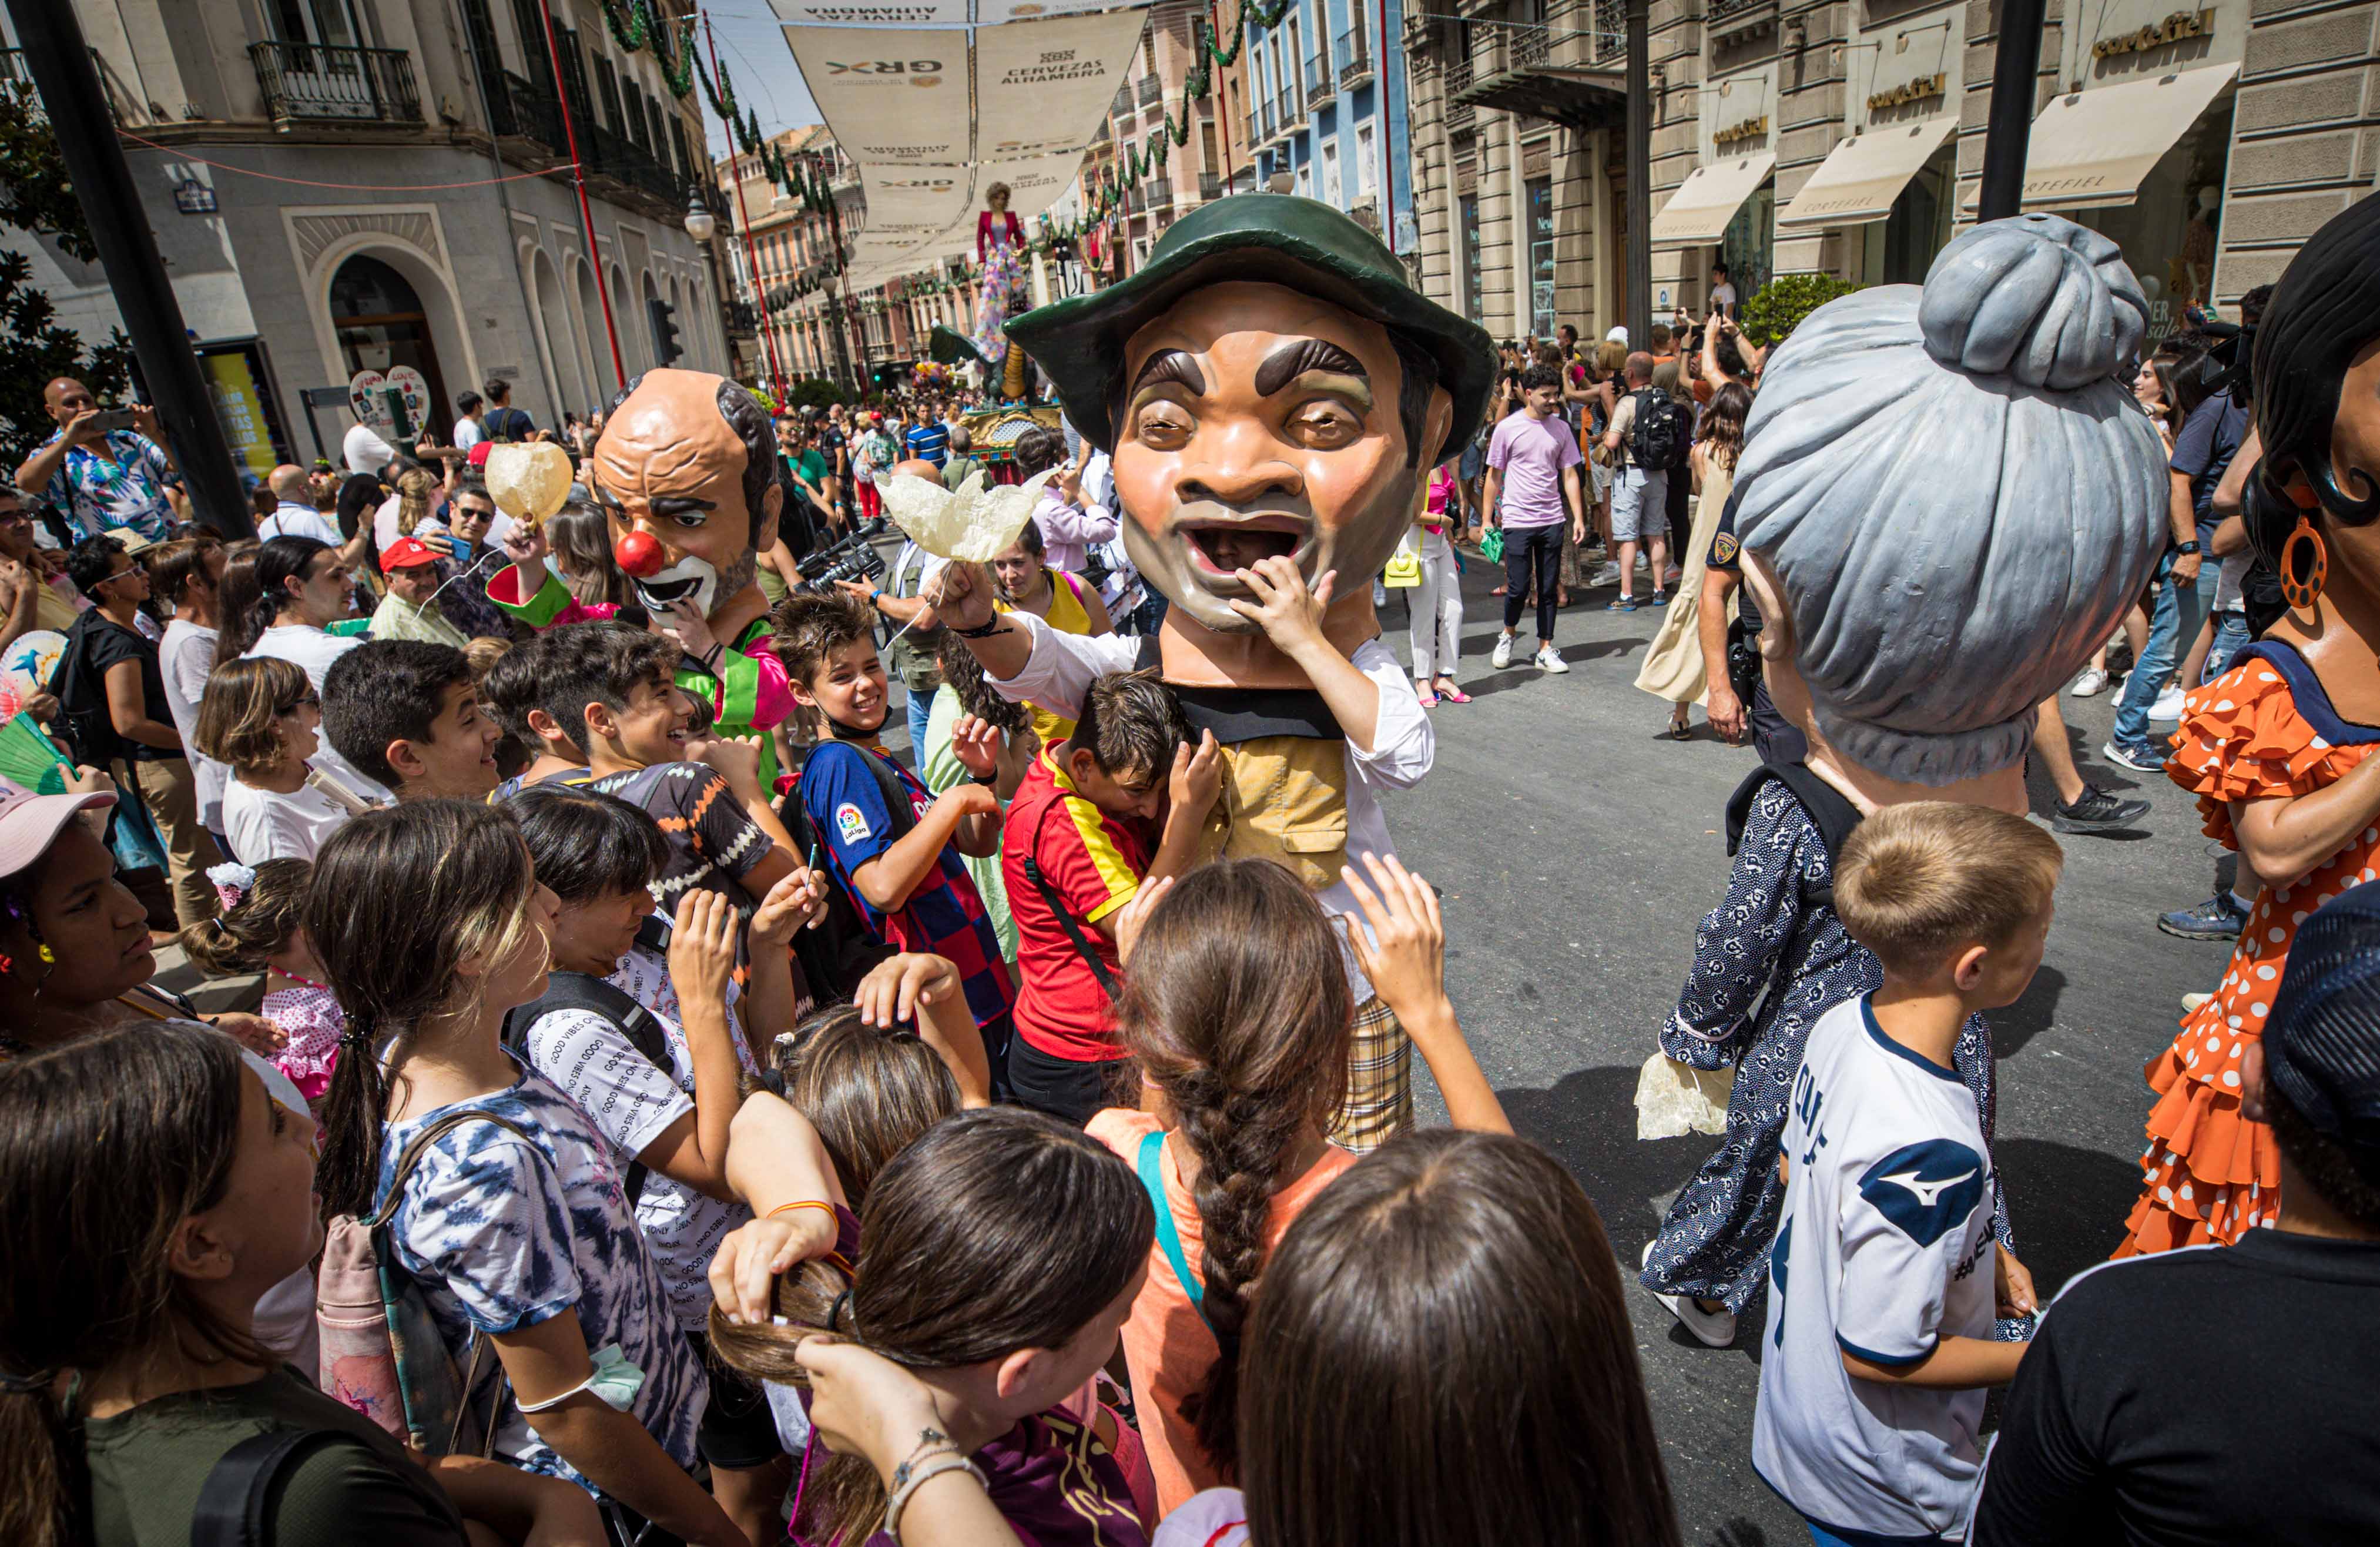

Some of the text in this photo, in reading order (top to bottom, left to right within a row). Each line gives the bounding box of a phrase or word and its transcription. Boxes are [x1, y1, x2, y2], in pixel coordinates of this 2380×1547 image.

[804, 6, 937, 14] ALHAMBRA
[2092, 8, 2216, 58] cortefiel
[1008, 59, 1102, 76] CERVEZAS
[1001, 68, 1105, 85] ALHAMBRA
[1866, 73, 1946, 110] cortefiel
[2024, 176, 2106, 193] RTEFIEL
[1804, 196, 1874, 212] CORTEFIEL
[845, 826, 867, 839] LaLiga
[551, 1040, 566, 1064] GOOD
[562, 1022, 584, 1040] VIBES
[584, 1039, 604, 1060] GOOD
[571, 1061, 587, 1080] VIBES
[602, 1091, 619, 1114] GOOD
[709, 1215, 728, 1232] VIBES
[696, 1231, 711, 1248] ONLY
[682, 1257, 704, 1275] GOOD
